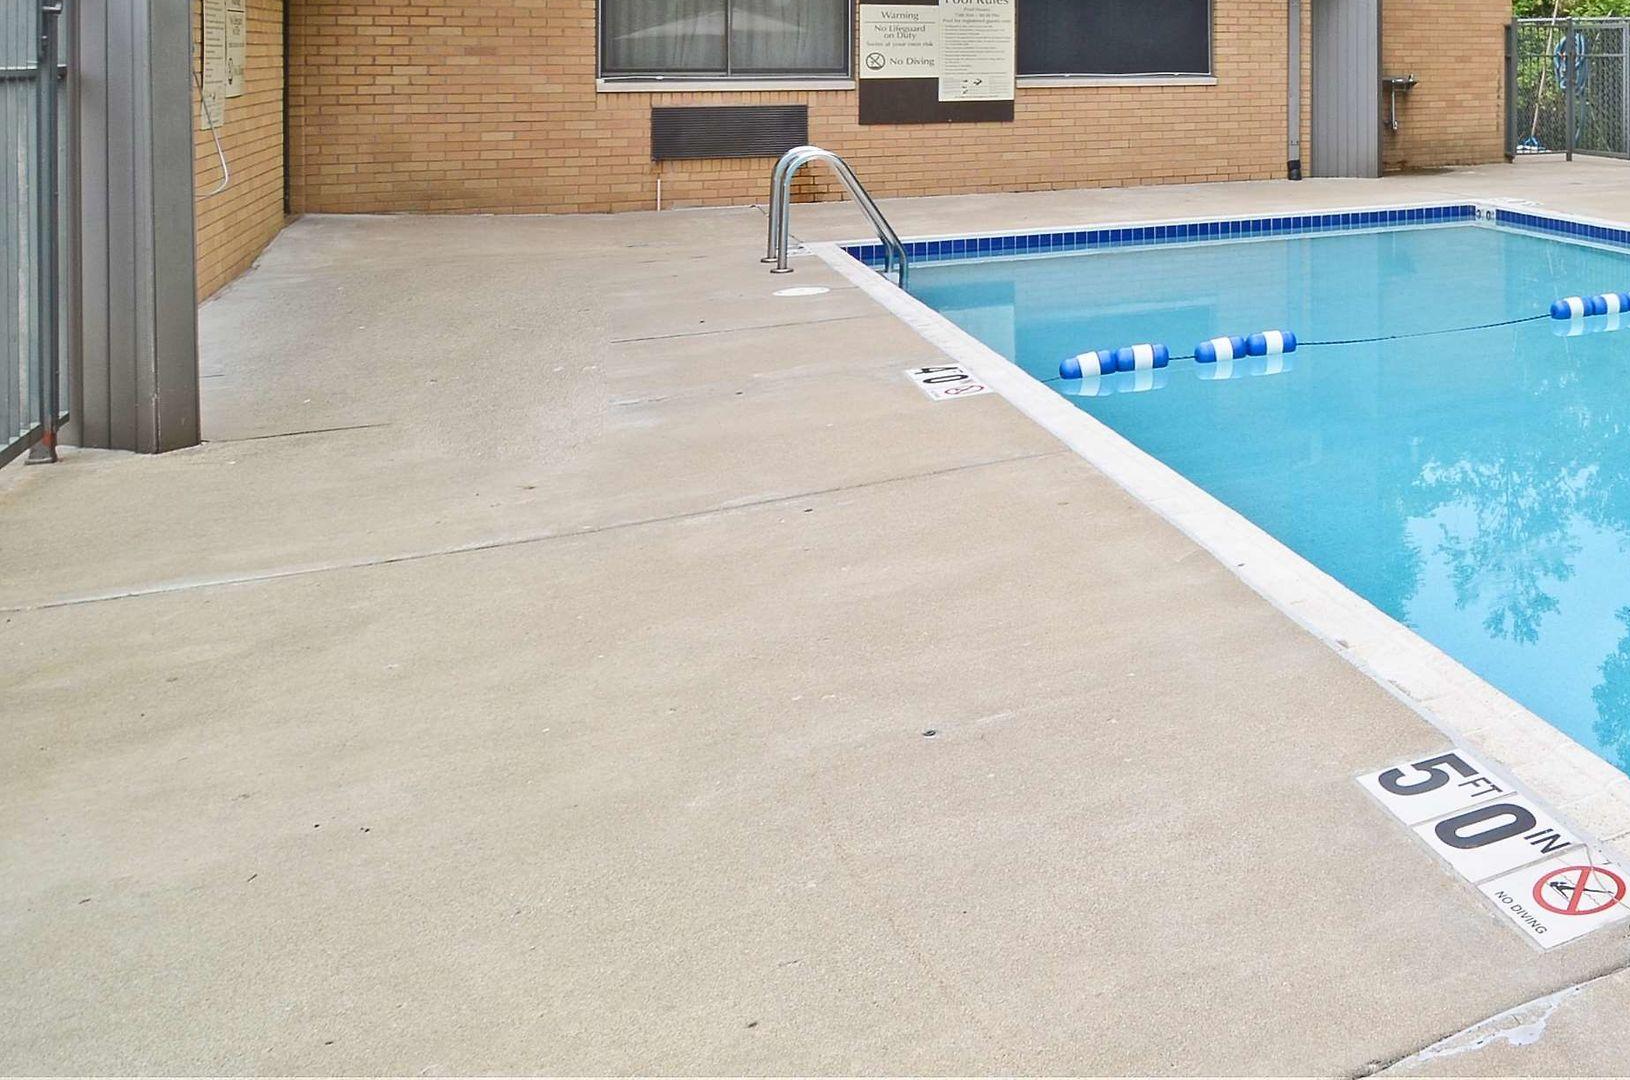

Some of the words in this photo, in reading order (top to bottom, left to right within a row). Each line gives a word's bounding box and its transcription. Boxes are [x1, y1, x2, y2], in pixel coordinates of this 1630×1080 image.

[881, 10, 919, 21] Warning
[889, 25, 926, 33] Lifeguard
[896, 32, 916, 40] Duty
[889, 57, 903, 65] No
[906, 56, 935, 67] Diving
[1378, 752, 1480, 796] 5
[1457, 776, 1504, 798] FT
[1434, 803, 1538, 850] 0
[1523, 827, 1571, 855] IN
[1494, 890, 1514, 905] NO
[1510, 903, 1548, 936] DIVING
